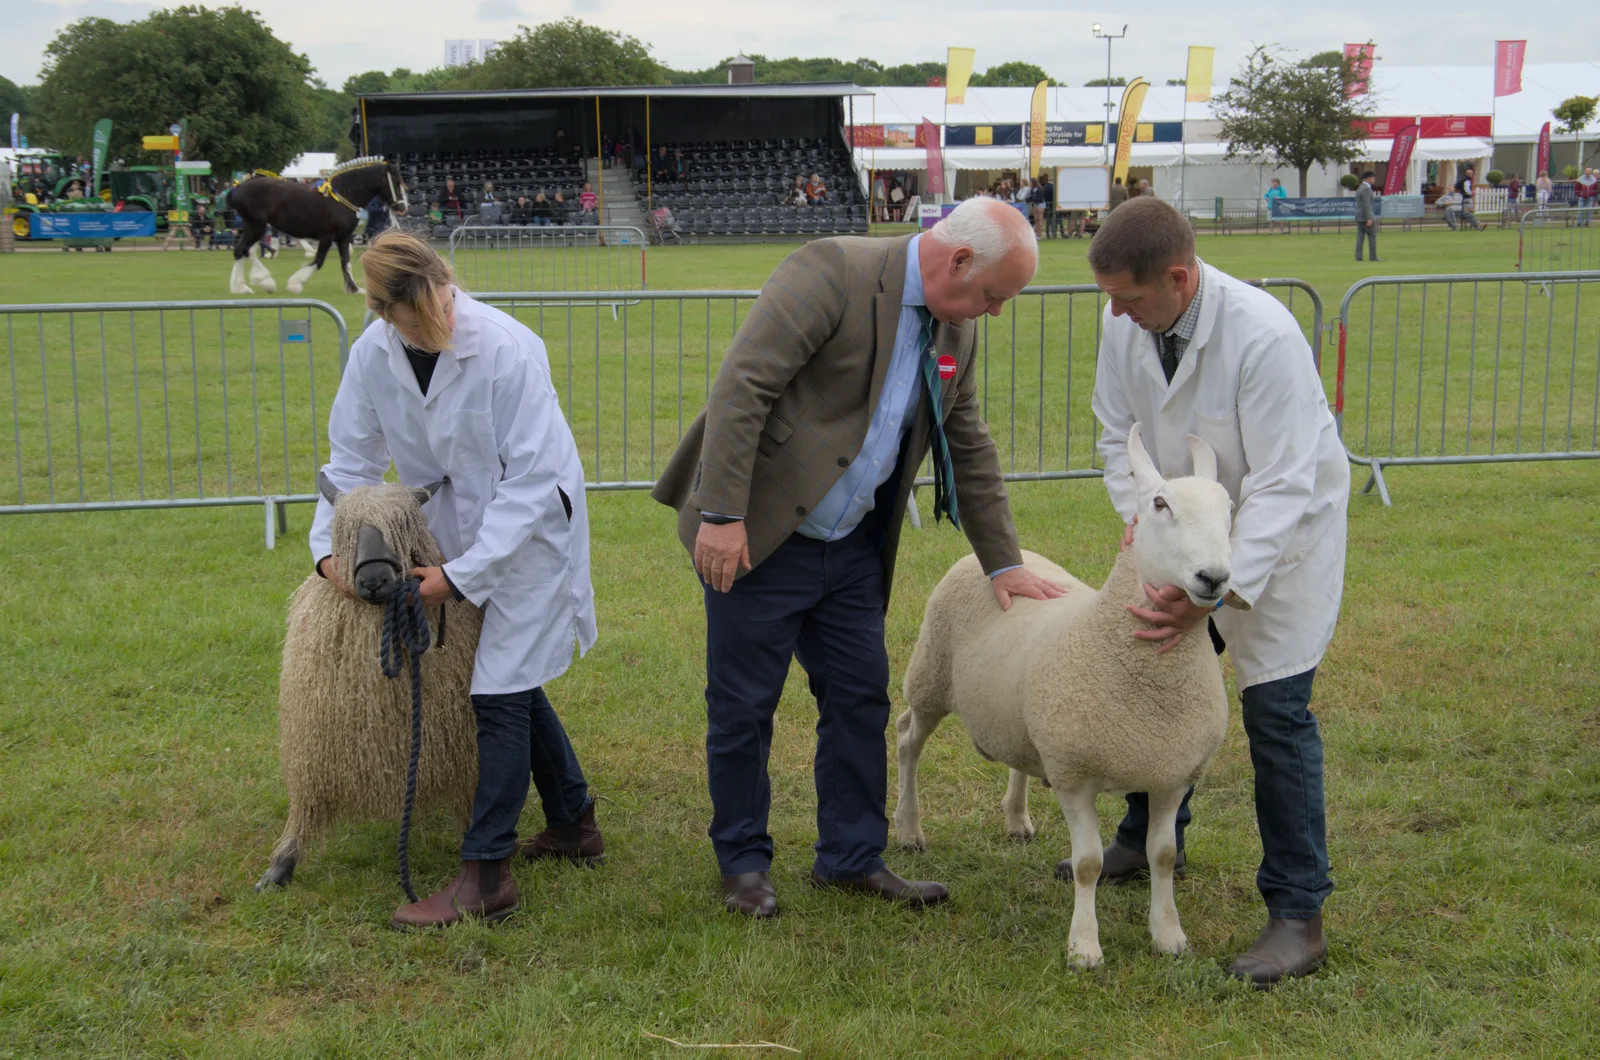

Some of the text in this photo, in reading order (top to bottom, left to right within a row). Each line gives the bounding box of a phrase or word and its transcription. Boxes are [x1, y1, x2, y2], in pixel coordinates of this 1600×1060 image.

[1031, 112, 1043, 159] savills
[1053, 124, 1063, 132] for
[1118, 113, 1135, 161] savills
